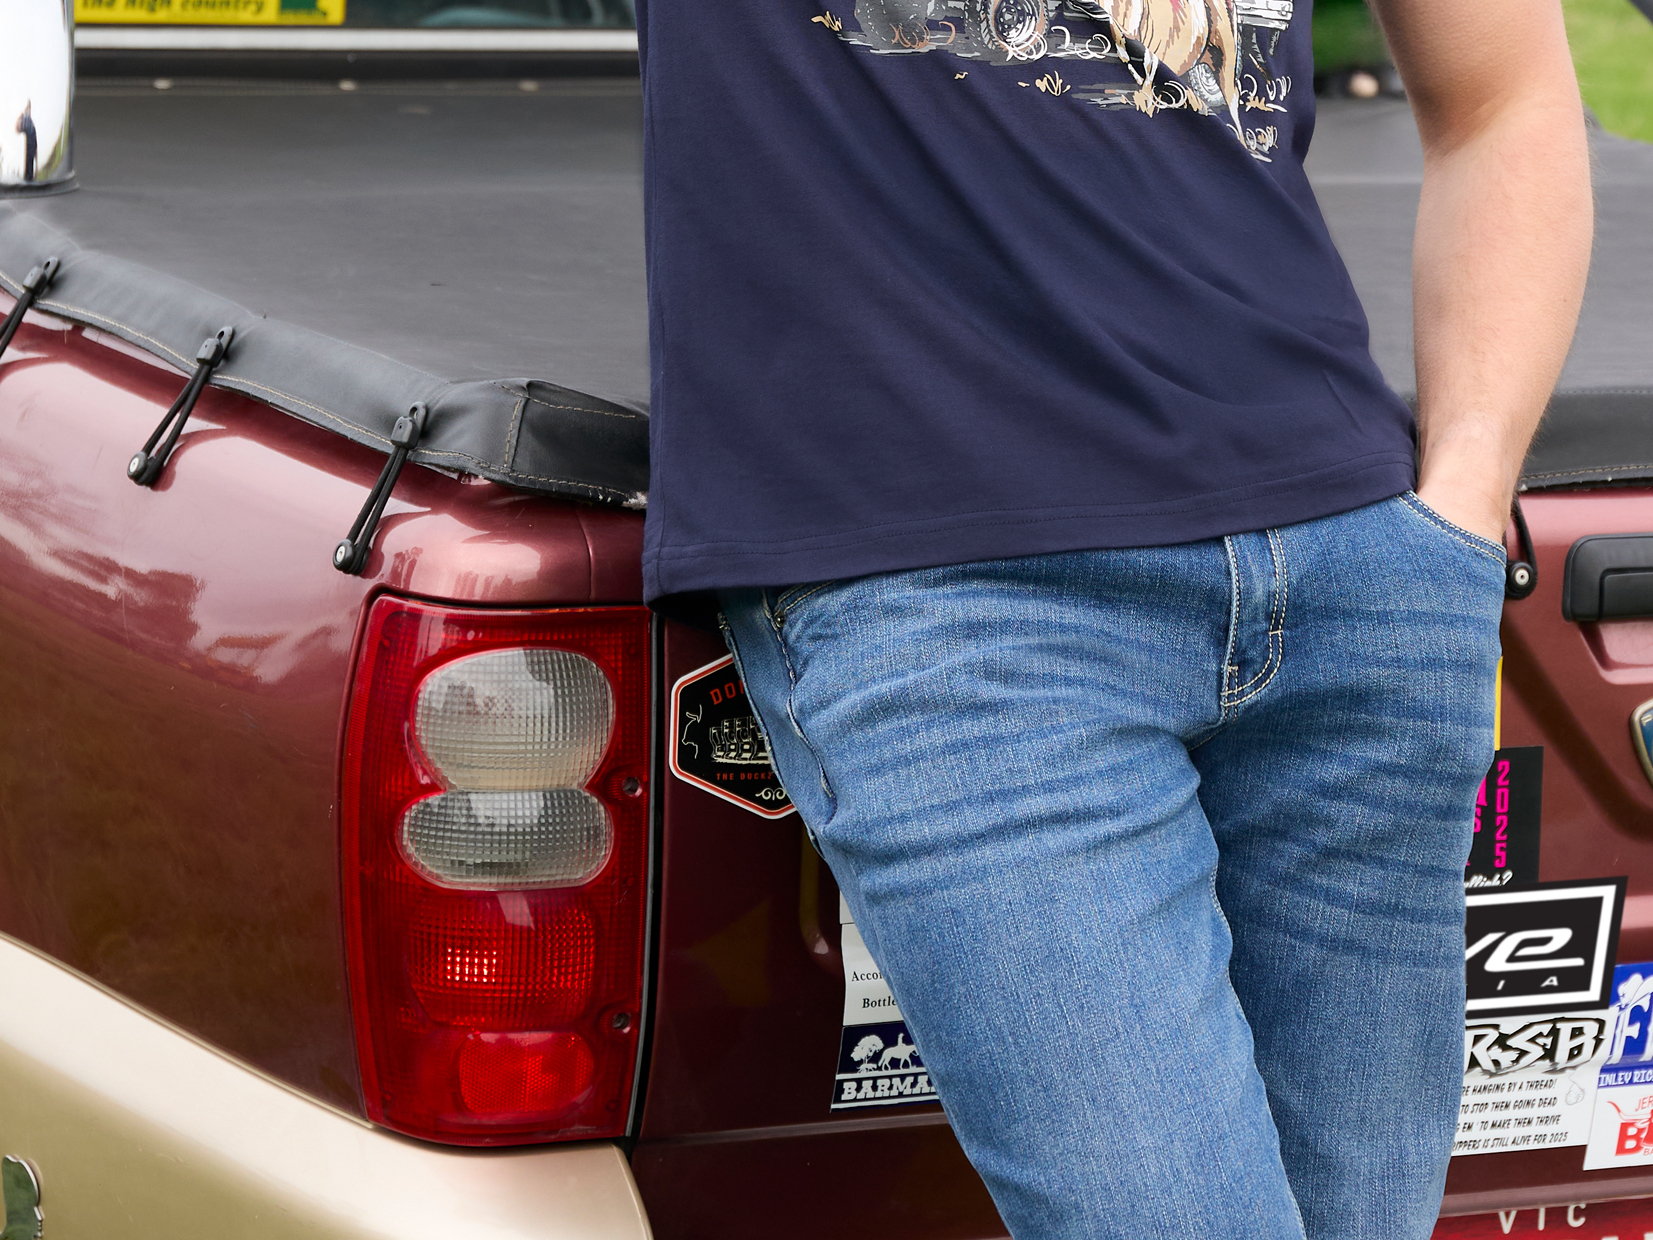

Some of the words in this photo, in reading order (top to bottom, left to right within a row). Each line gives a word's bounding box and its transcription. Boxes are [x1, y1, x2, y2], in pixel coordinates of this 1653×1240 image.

[716, 772, 734, 780] THE
[1494, 760, 1510, 868] 2025
[841, 1075, 936, 1101] BARMA
[1472, 1083, 1506, 1096] HANGING
[1507, 1082, 1518, 1092] BY
[1525, 1079, 1558, 1091] THREAD!
[1460, 1104, 1469, 1114] TO
[1470, 1102, 1489, 1114] STOP
[1490, 1100, 1511, 1112] THEM
[1513, 1098, 1536, 1111] GOING
[1537, 1097, 1558, 1108] DEAD
[1490, 1119, 1512, 1131] MAKE
[1513, 1117, 1533, 1129] THEM
[1535, 1115, 1561, 1127] THRIVE
[1482, 1138, 1489, 1149] IS
[1491, 1136, 1509, 1148] STILL
[1511, 1134, 1532, 1146] ALIVE
[1534, 1133, 1547, 1145] FOR
[1549, 1131, 1569, 1143] 2025
[1498, 1203, 1586, 1235] VIC
